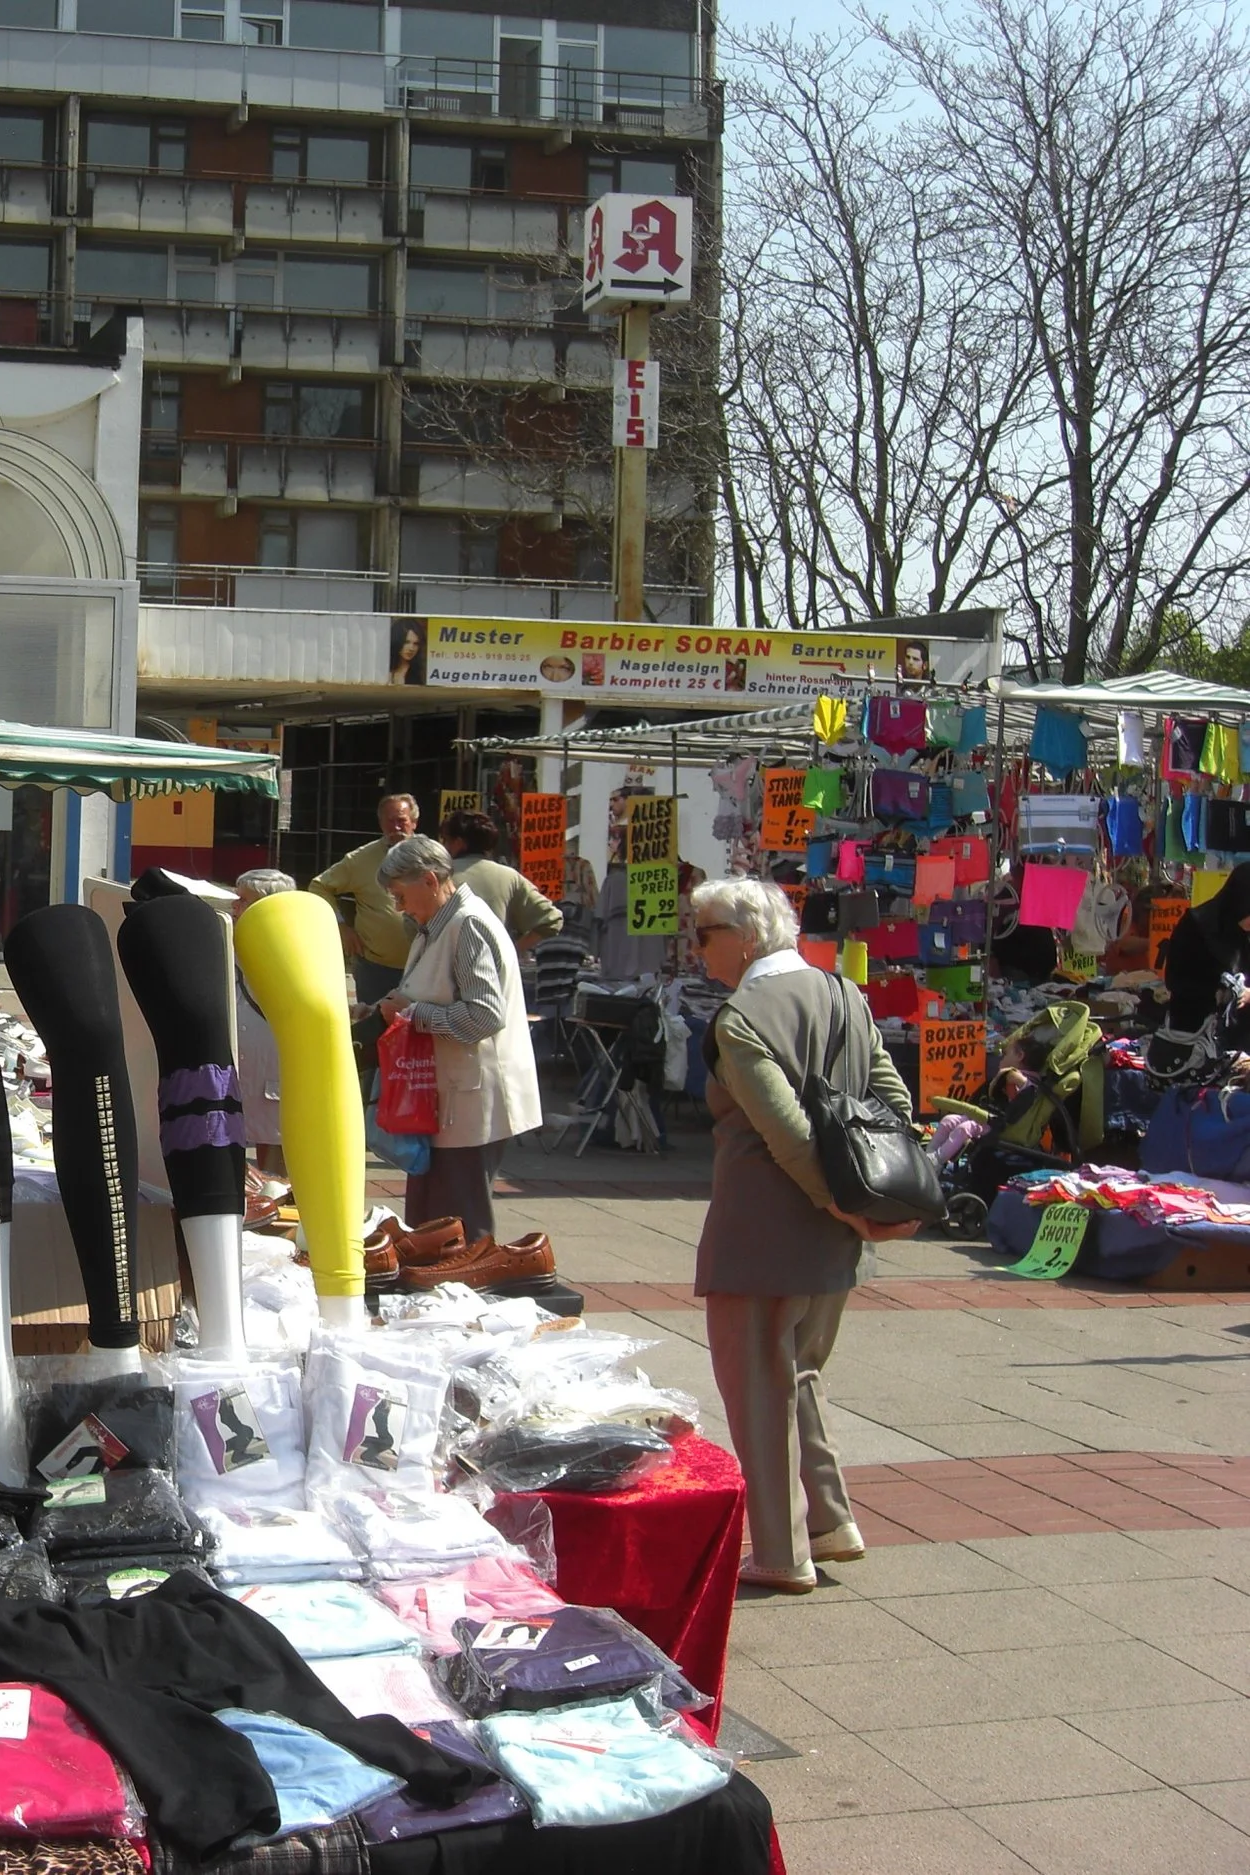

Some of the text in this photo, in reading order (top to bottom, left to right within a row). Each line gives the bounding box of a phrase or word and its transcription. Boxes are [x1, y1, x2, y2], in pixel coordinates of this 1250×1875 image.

[438, 627, 524, 645] Muster
[560, 630, 772, 657] Barbier SORAN
[453, 651, 477, 660] 0345
[791, 643, 887, 660] Bartrasur
[620, 659, 720, 675] Nageldesign
[430, 668, 538, 684] Augenbrauen
[610, 675, 722, 690] komplett 25 €
[766, 672, 797, 683] hinter
[768, 776, 807, 793] STRIN
[444, 794, 477, 812] ALLES
[524, 798, 562, 814] ALLES
[772, 791, 803, 808] TANG
[632, 799, 674, 824] ALLES
[524, 815, 561, 832] MUSS
[632, 819, 671, 844] MUSS
[524, 833, 563, 851] RAUS!
[632, 839, 670, 864] RAUS
[524, 860, 558, 873] SUPER
[532, 870, 562, 882] PREIS
[630, 868, 669, 885] SUPER
[641, 879, 675, 895] PREIS
[1072, 955, 1094, 970] PREIS
[926, 1041, 977, 1062] SHORT
[1039, 1224, 1079, 1244] SHORT
